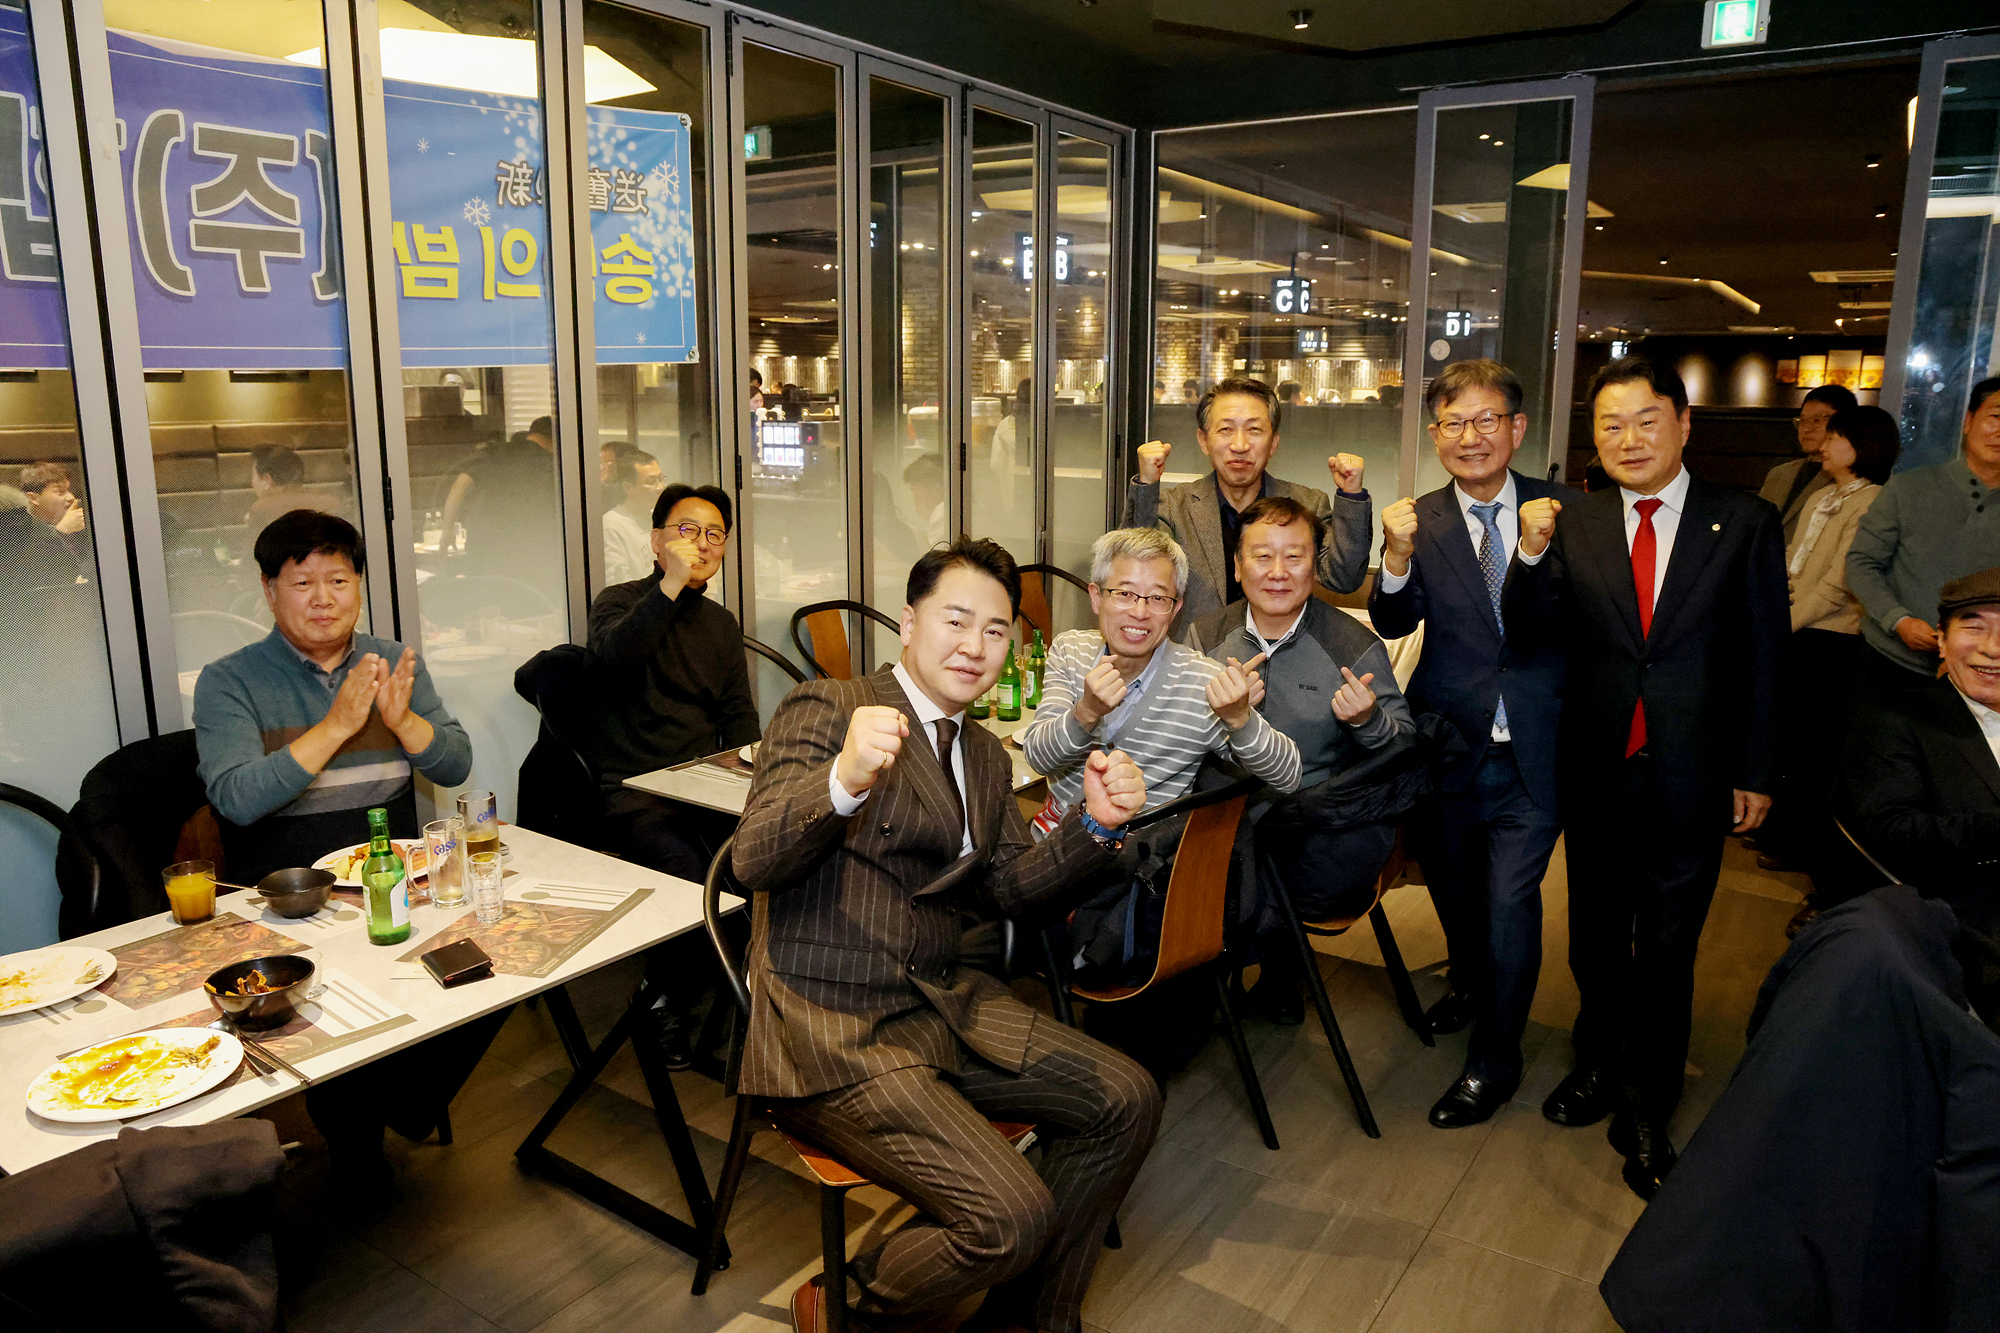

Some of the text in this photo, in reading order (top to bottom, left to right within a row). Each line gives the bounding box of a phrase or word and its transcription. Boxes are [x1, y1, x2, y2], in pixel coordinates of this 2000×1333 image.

[1056, 249, 1068, 280] B
[1276, 289, 1293, 313] C
[1301, 290, 1309, 313] C
[1446, 318, 1460, 336] D
